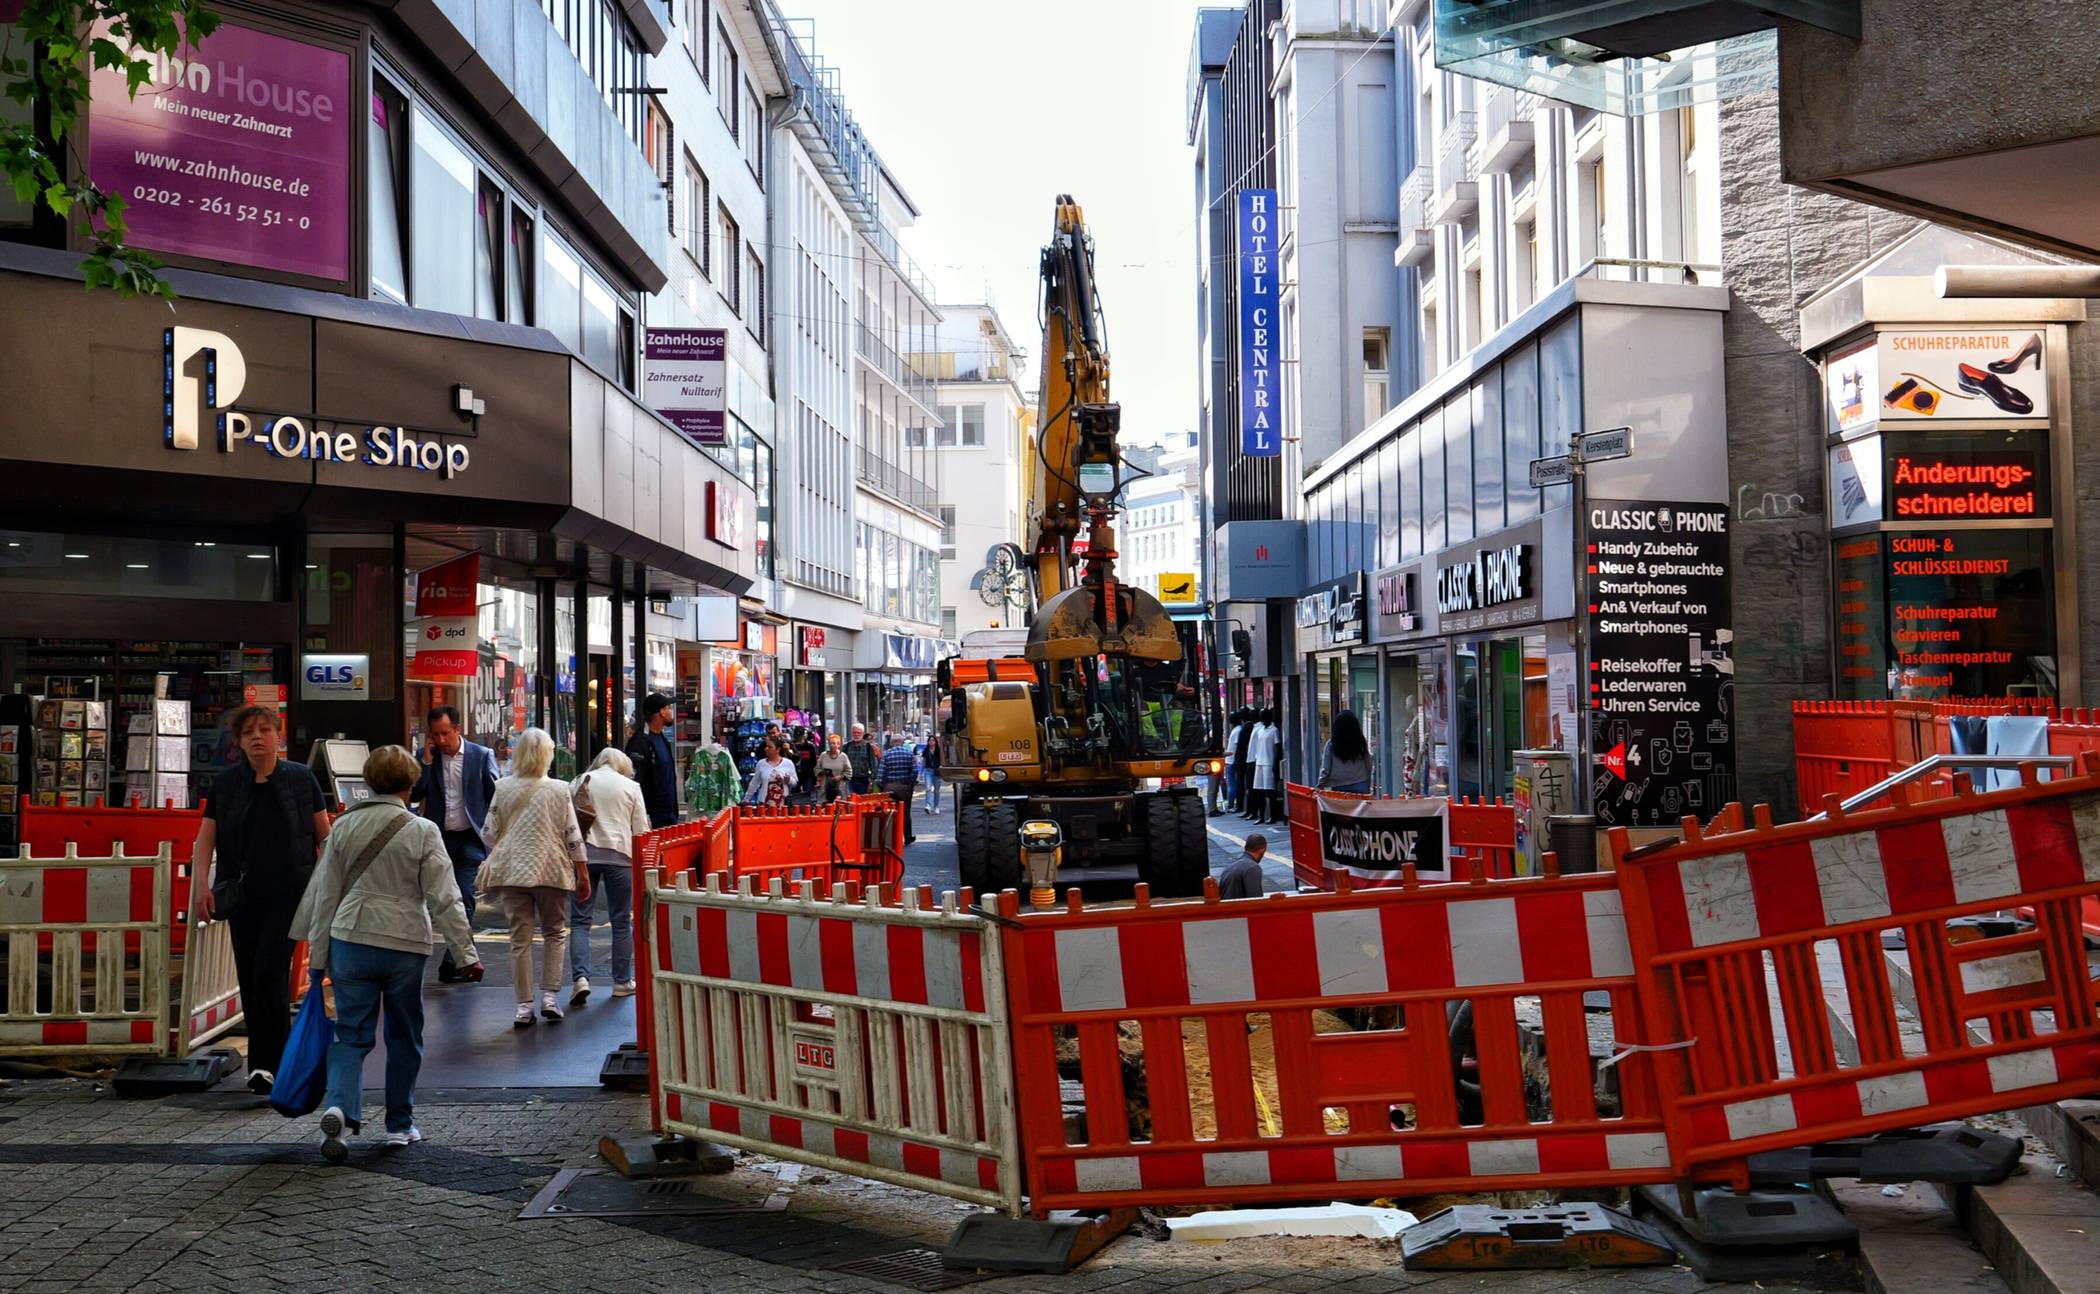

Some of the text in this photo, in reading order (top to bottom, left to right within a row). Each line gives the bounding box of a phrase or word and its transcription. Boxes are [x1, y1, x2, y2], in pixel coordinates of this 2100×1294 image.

[217, 60, 333, 122] House
[154, 96, 293, 139] Mein neuer Zahnarzt
[134, 150, 310, 197] www.zahnhouse.de
[133, 185, 181, 206] 0202
[200, 196, 232, 216] 261
[236, 204, 258, 222] 52
[262, 209, 281, 226] 51
[299, 216, 310, 229] 0
[1251, 195, 1269, 450] HOTEL CENTRAL
[647, 333, 724, 347] ZahnHouse
[1892, 335, 2009, 351] SCHUHREPARATUR
[647, 372, 705, 383] Zahnersatz
[681, 387, 723, 399] Nulltarif
[224, 412, 358, 463] P-One
[368, 426, 470, 480] Shop
[1895, 458, 2032, 489] Änderungs-
[1897, 491, 2035, 515] schneiderei
[1591, 509, 1726, 533] CLASSIC PHONE
[1598, 541, 1699, 558] Handy Zubehör
[1892, 538, 1942, 553] SCHUH-
[1943, 538, 1954, 552] &
[1598, 561, 1724, 578] Neue & gebrauchte
[1892, 558, 2009, 576] SCHLÜSSELDIENST
[1436, 544, 1522, 614] CLASSIC PHONE
[420, 582, 448, 599] ria
[1599, 580, 1688, 597] Smartphones
[1599, 601, 1707, 615] An& Verkauf von
[1895, 603, 1999, 623] Schuhreparatur
[444, 627, 466, 639] dpd
[1600, 620, 1689, 636] Smartphones
[1896, 627, 1961, 642] Gravieren
[423, 656, 467, 669] Pickup
[1601, 658, 1683, 673] Reisekoffer
[1899, 650, 2013, 667] Taschenreparatur
[306, 665, 353, 684] GLS
[1900, 671, 1953, 688] Stempel
[1601, 678, 1687, 693] Lederwaren
[1602, 698, 1701, 713] Uhren Service
[475, 703, 501, 735] SHOP
[1009, 739, 1031, 750] 108
[1607, 744, 1642, 766] Nr. 4
[1359, 830, 1418, 861] PHONE
[798, 1044, 833, 1066] LTG
[1578, 1236, 1611, 1251] LTG
